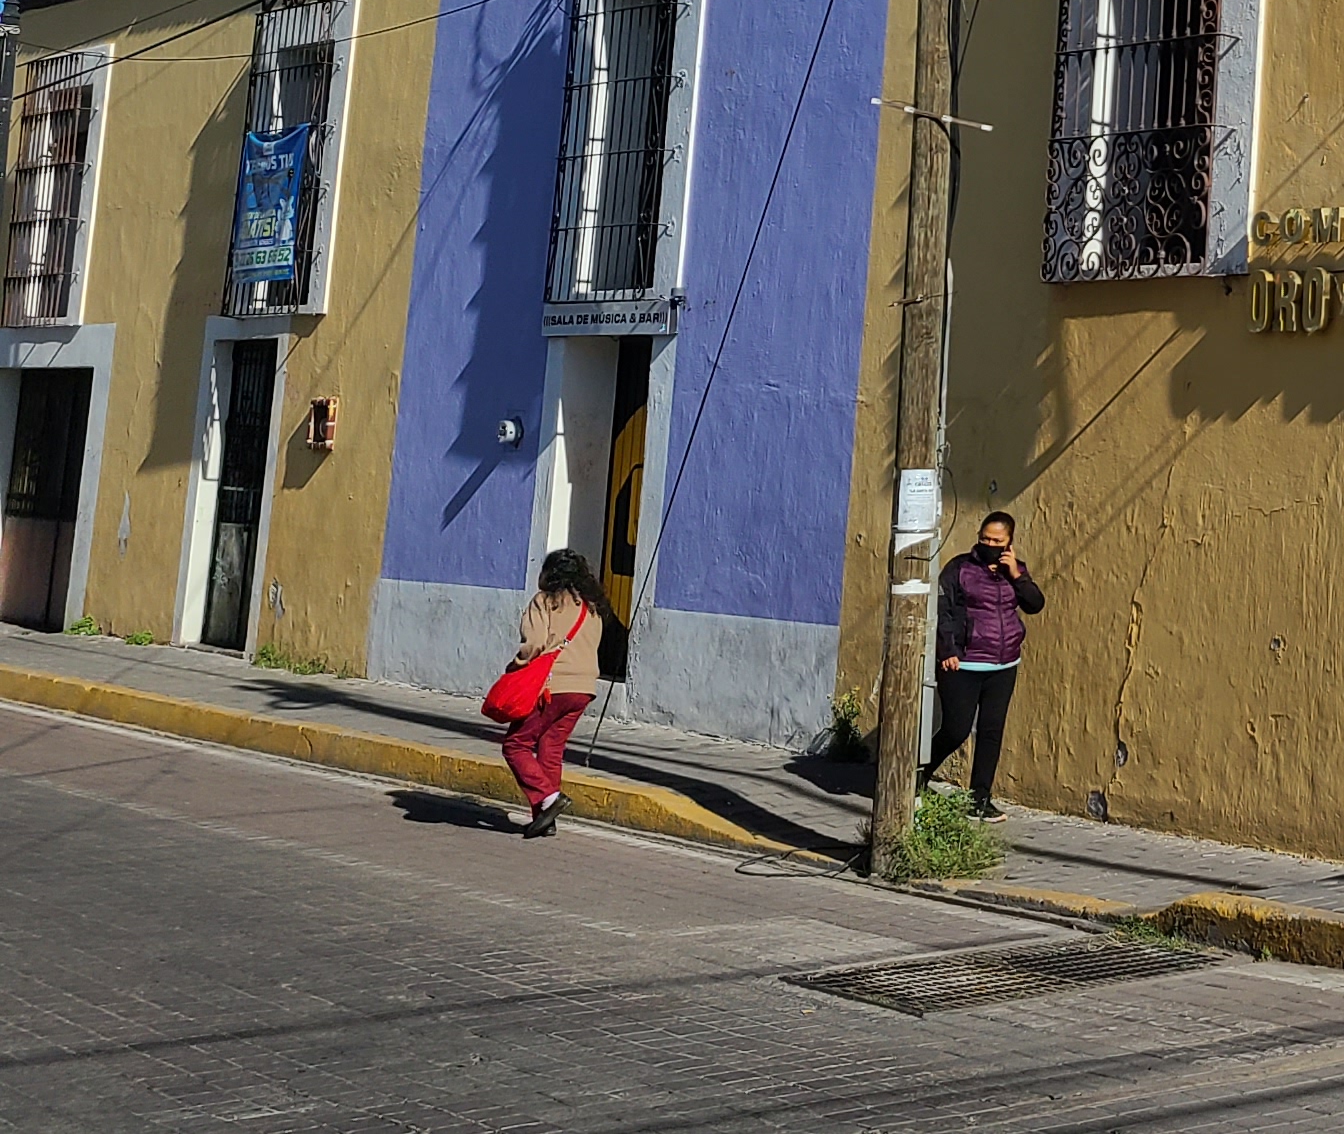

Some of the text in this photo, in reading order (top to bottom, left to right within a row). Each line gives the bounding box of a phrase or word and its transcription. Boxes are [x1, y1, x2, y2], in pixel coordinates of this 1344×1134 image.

[576, 314, 589, 325] DE
[591, 312, 626, 325] MÚSICA
[629, 313, 636, 323] &
[1250, 267, 1328, 332] ORO
